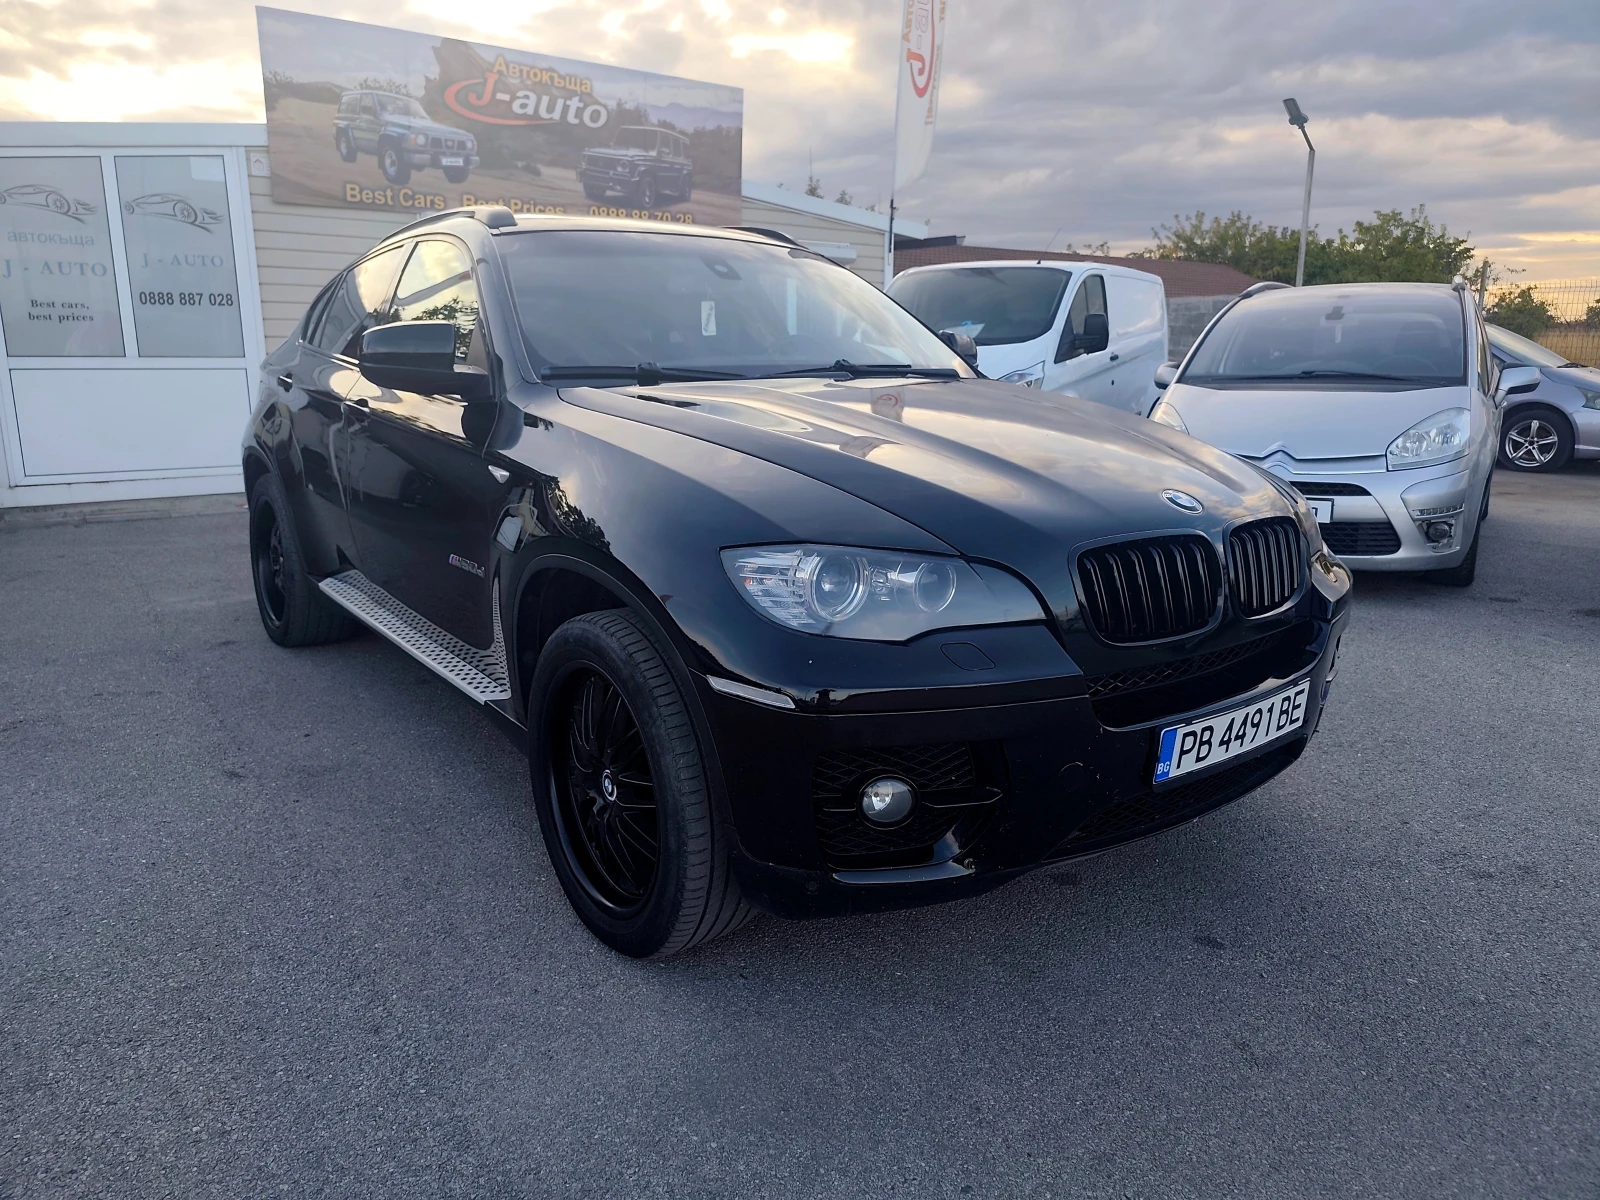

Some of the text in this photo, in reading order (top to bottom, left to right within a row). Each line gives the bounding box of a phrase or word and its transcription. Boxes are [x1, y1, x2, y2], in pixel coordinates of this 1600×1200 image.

[493, 56, 592, 94] Автокъща
[467, 72, 608, 128] J-auto
[345, 184, 393, 206] Best
[399, 188, 445, 210] Cars
[7, 230, 95, 247] автокъща
[40, 261, 108, 278] AUTO
[171, 254, 224, 268] AUTO
[30, 299, 90, 310] Best cars,
[139, 291, 234, 307] 0888 887 028
[28, 312, 94, 323] best prices
[1218, 702, 1275, 753] 4491
[1156, 761, 1170, 775] BG
